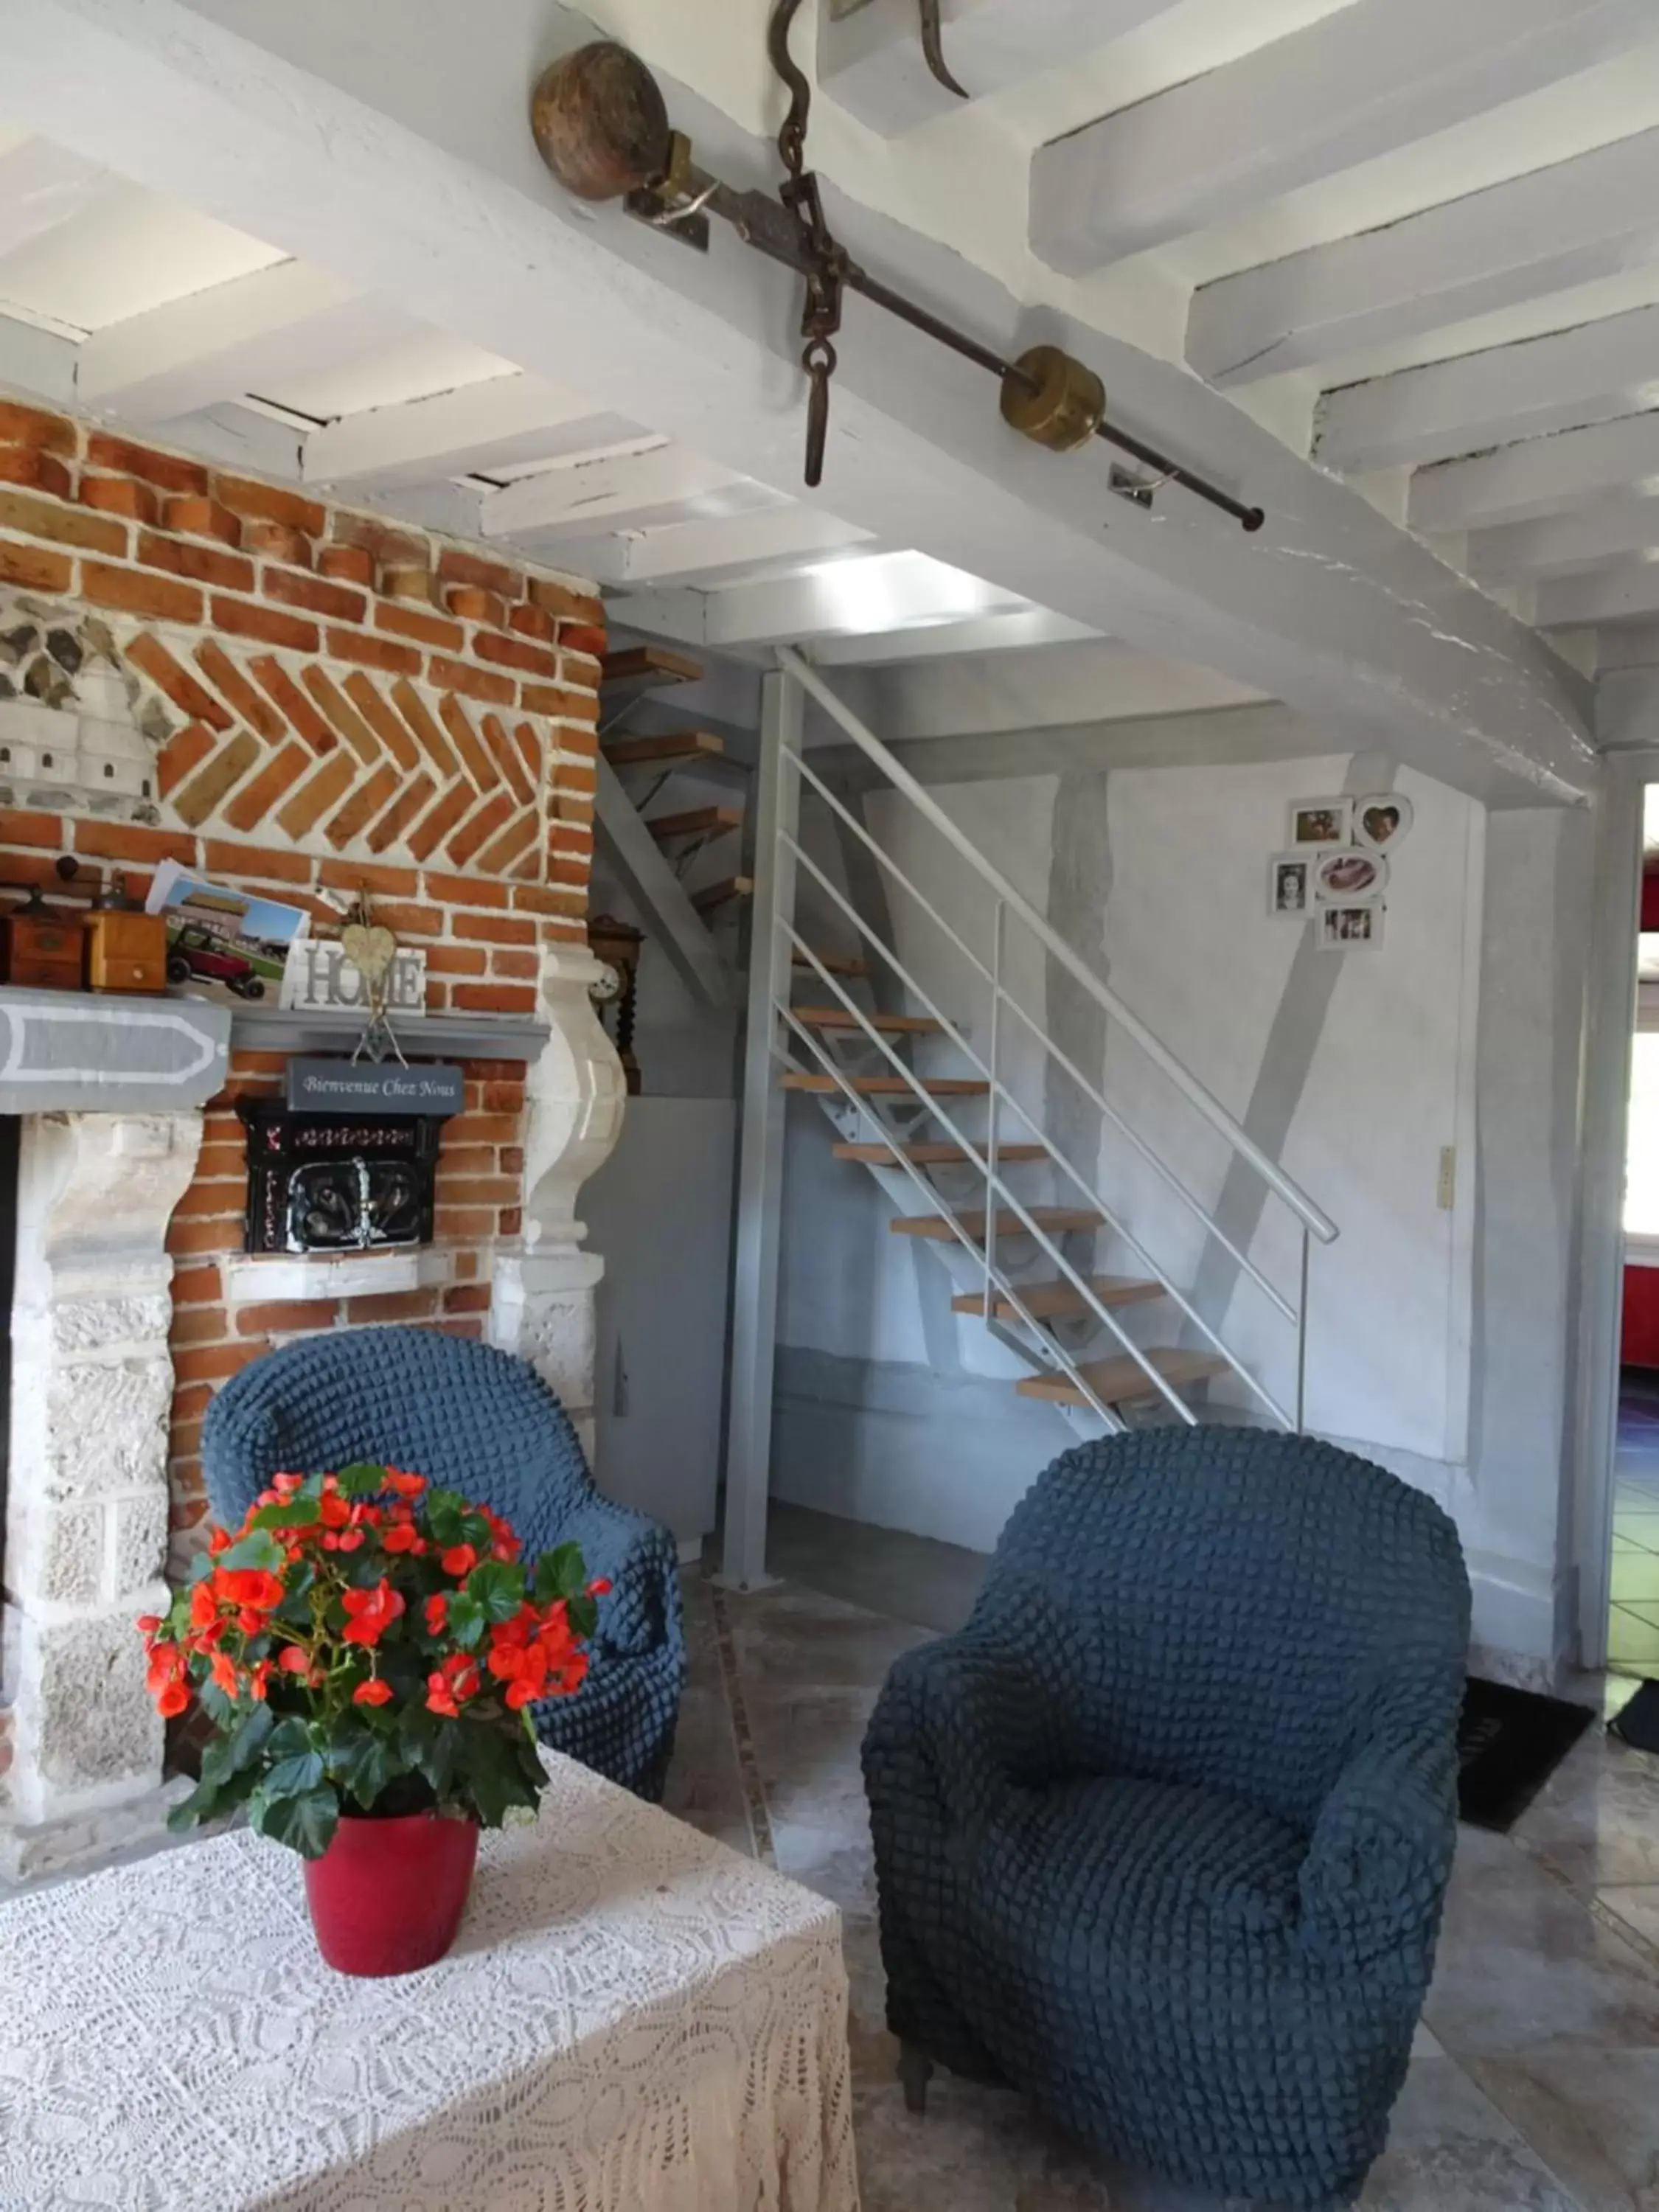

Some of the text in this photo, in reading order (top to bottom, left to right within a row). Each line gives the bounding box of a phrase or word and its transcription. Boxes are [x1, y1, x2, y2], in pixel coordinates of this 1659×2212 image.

[302, 1076, 455, 1097] Bienvenue Chez Nous
